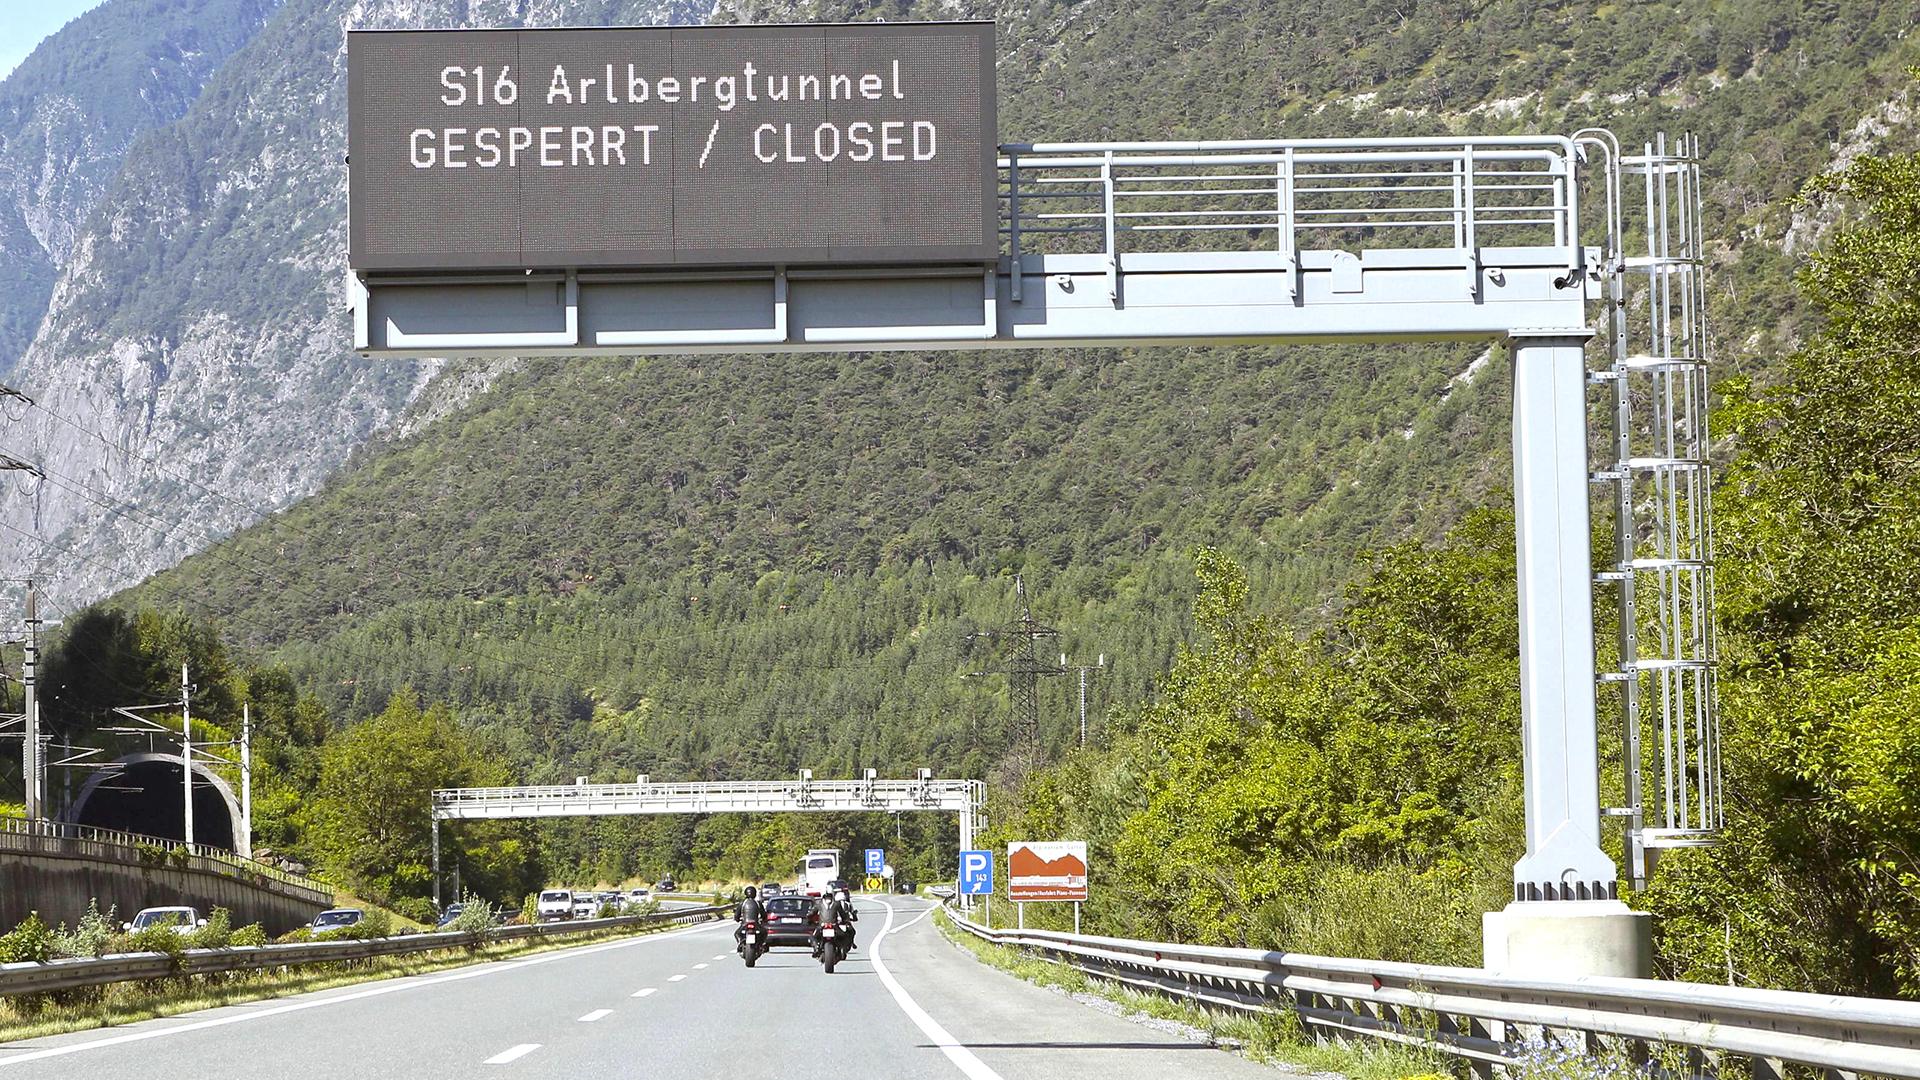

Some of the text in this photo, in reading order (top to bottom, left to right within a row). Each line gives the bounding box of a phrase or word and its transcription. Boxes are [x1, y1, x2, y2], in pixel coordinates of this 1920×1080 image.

[440, 59, 905, 112] S16 Arlbergtunnel
[410, 119, 937, 169] GESPERRT / CLOSED
[868, 851, 881, 867] P
[965, 854, 987, 882] P
[976, 873, 987, 882] 143
